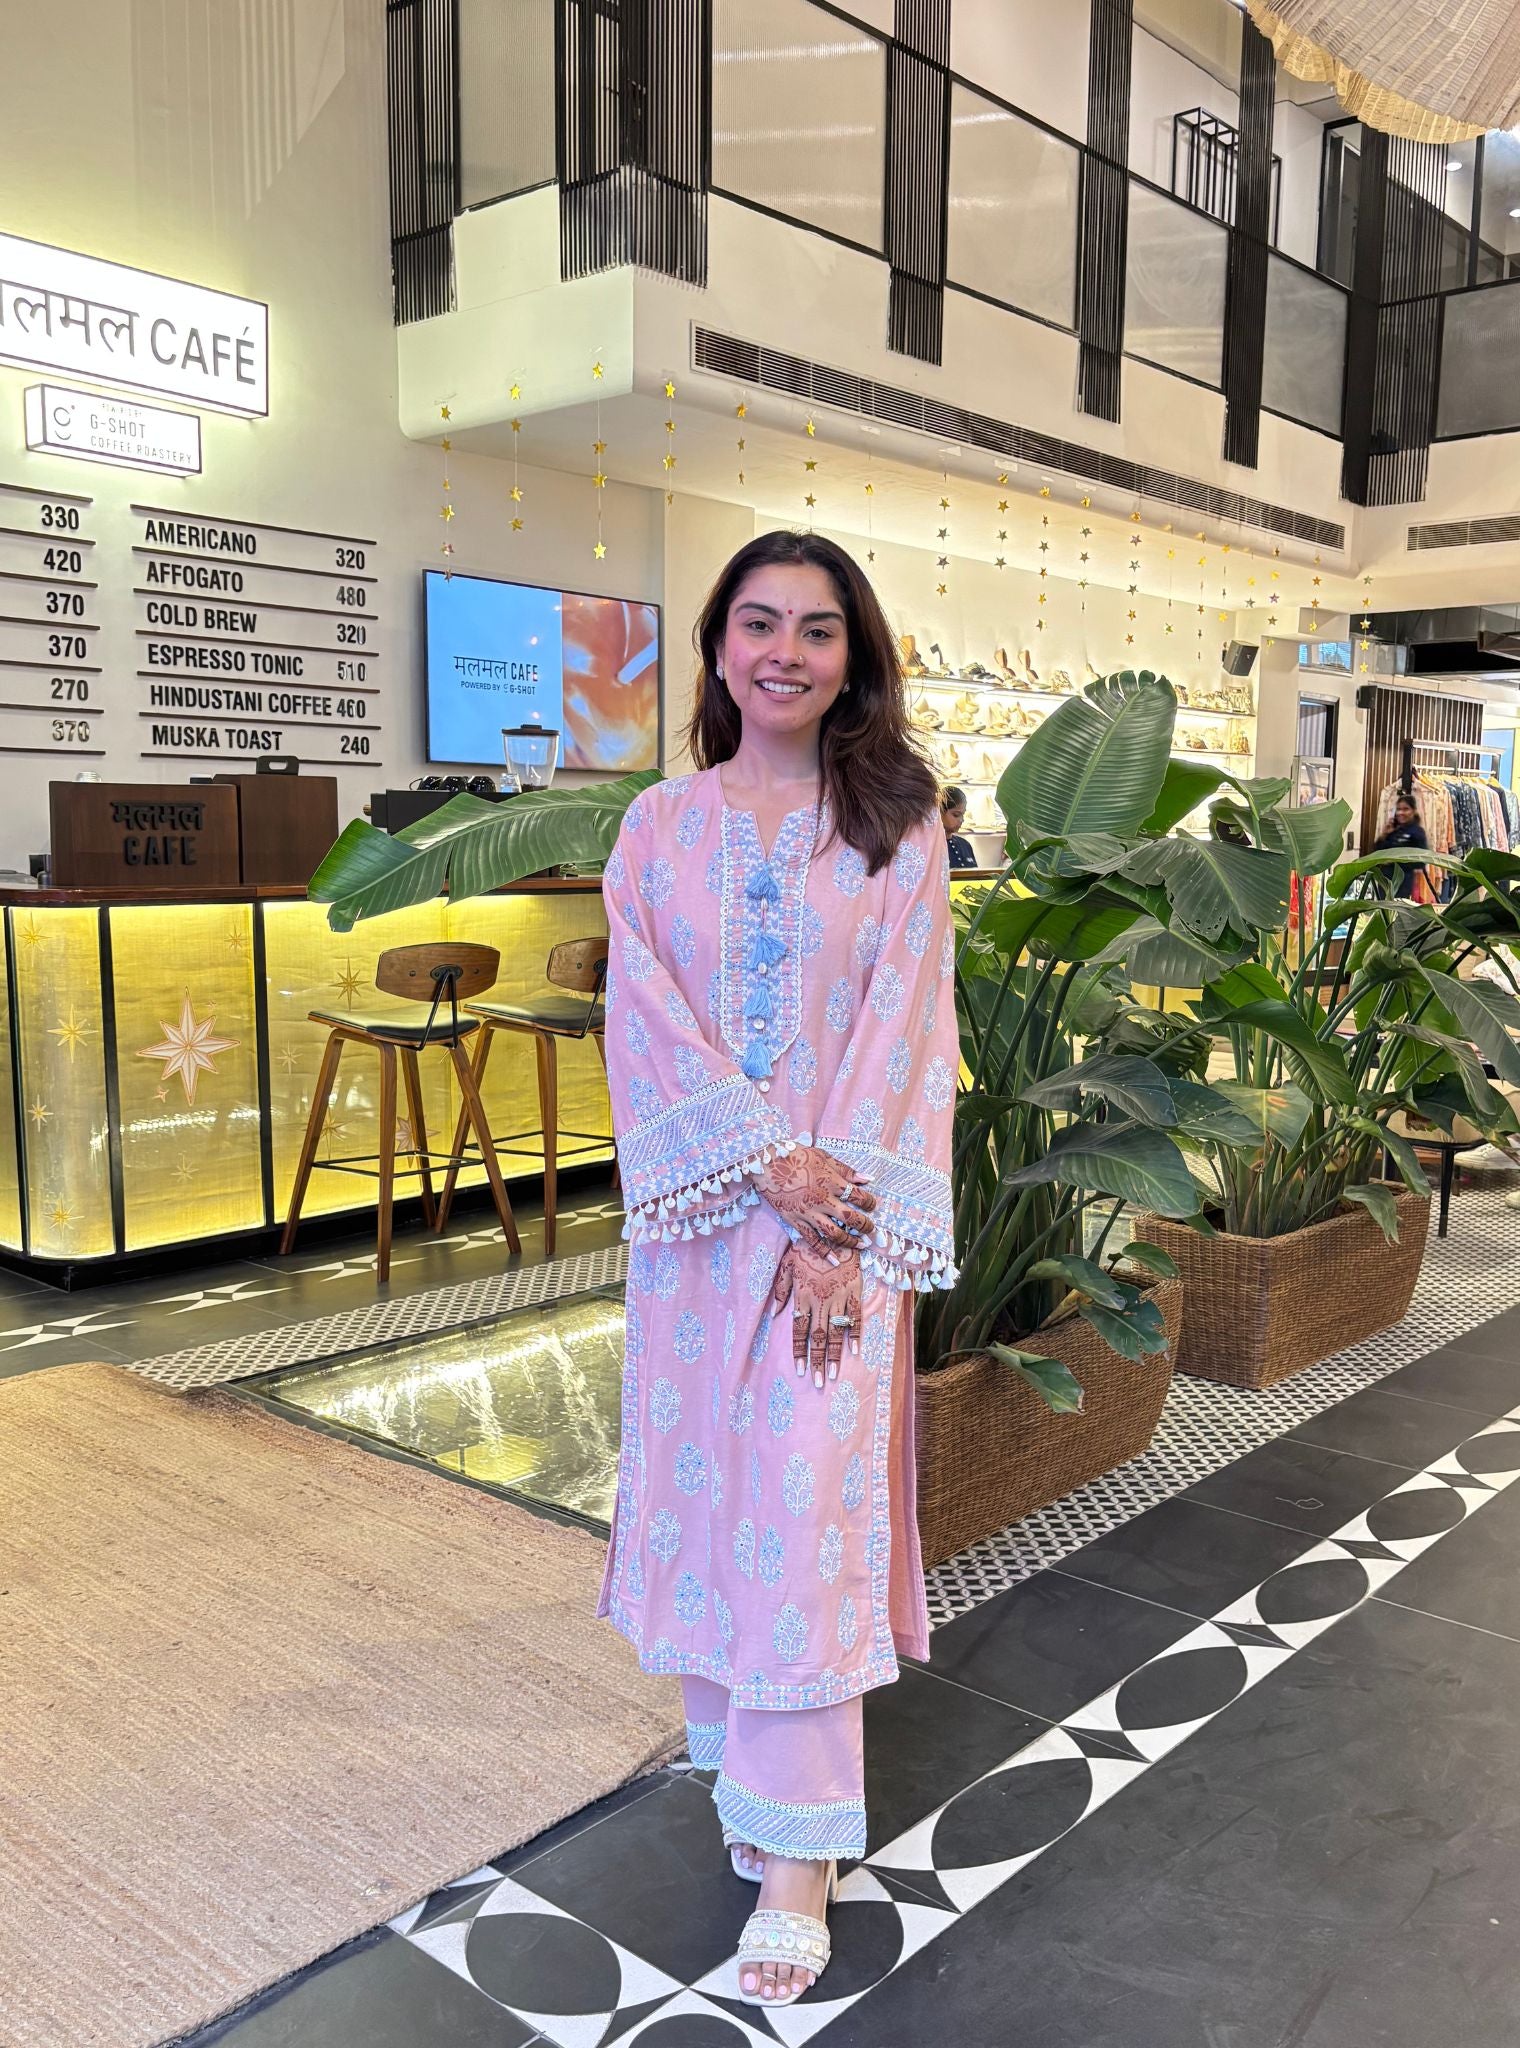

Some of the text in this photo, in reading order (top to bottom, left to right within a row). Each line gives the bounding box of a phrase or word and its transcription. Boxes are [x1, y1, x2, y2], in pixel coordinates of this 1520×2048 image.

[0, 278, 256, 385] लमल CAFÉ
[90, 414, 146, 438] G-SHOT
[91, 436, 192, 464] COFFEE ROASTERY
[41, 504, 79, 530] 330
[145, 519, 365, 570] AMERICANO 320
[44, 548, 81, 573] 420
[147, 561, 366, 607] AFFOGATO 480
[46, 591, 84, 616] 370
[147, 602, 366, 645] COLD BREW 320
[49, 635, 87, 659] 370
[148, 643, 366, 681] ESPRESSO TONIC 510
[453, 656, 538, 682] मलमल CAFE
[51, 678, 89, 701] 270
[150, 685, 366, 719] HINDUSTANI COFFEE 460
[461, 681, 536, 695] POWERED BY G-SHOT
[52, 719, 90, 742] 370
[152, 725, 370, 755] MUSKA TOAST 240
[110, 802, 205, 831] मलमल
[124, 836, 198, 866] CAFE
